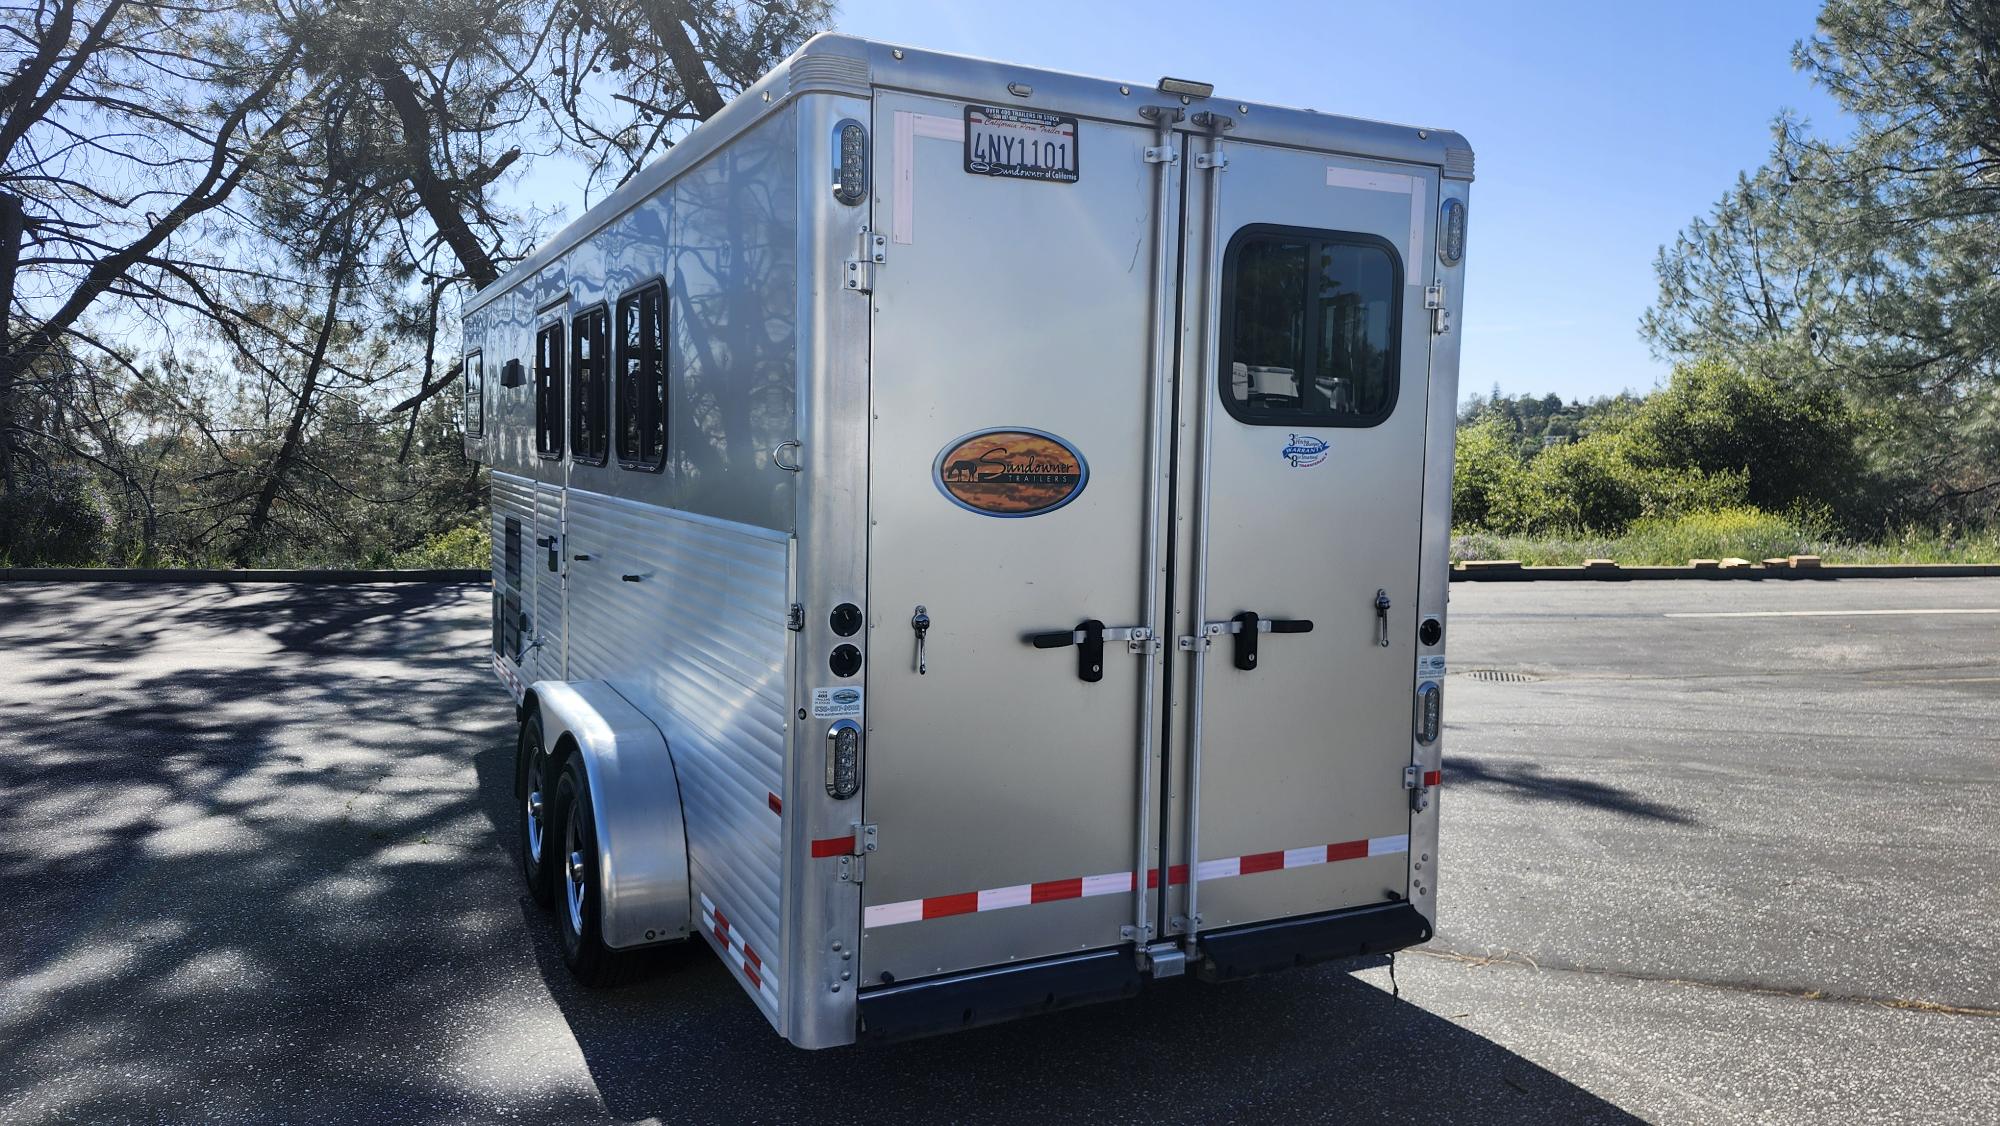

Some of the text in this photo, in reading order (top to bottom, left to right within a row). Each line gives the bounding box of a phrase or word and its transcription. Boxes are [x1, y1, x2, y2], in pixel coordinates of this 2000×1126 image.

[1012, 109, 1036, 119] TRAILERS
[984, 118, 1017, 129] California
[1040, 125, 1061, 135] Trailer
[974, 132, 1066, 170] 4NY1101
[990, 161, 1045, 178] Sundowner
[1051, 171, 1077, 181] California
[1288, 433, 1295, 446] 3
[979, 448, 1074, 480] Sundowner
[1291, 455, 1298, 467] 8
[1008, 474, 1068, 483] TRAILERS
